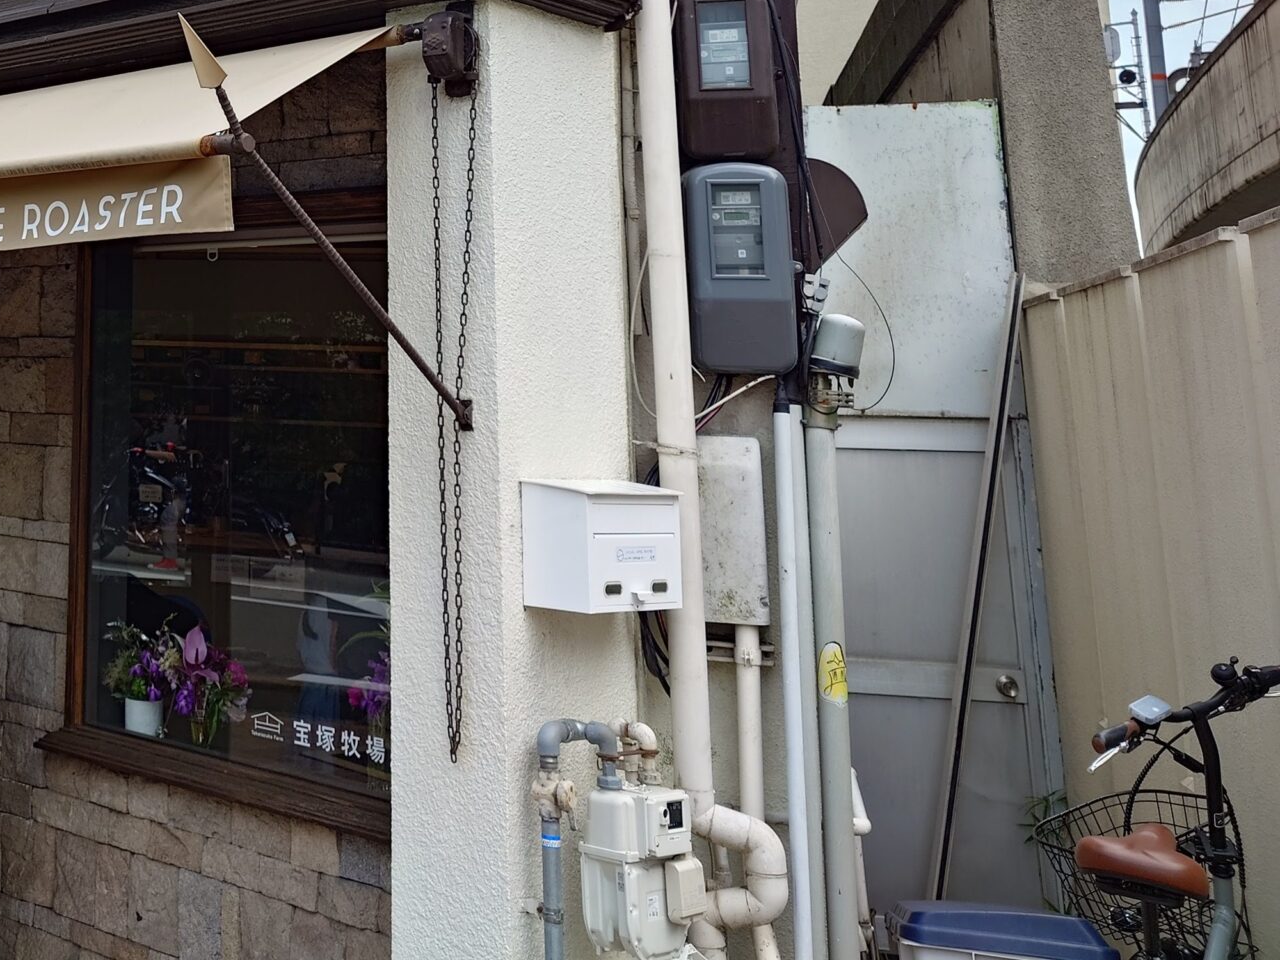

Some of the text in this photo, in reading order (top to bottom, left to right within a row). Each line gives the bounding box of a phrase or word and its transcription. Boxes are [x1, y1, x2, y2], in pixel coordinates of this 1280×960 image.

[22, 184, 184, 241] ROASTER
[293, 720, 386, 764] 宝塚牧場
